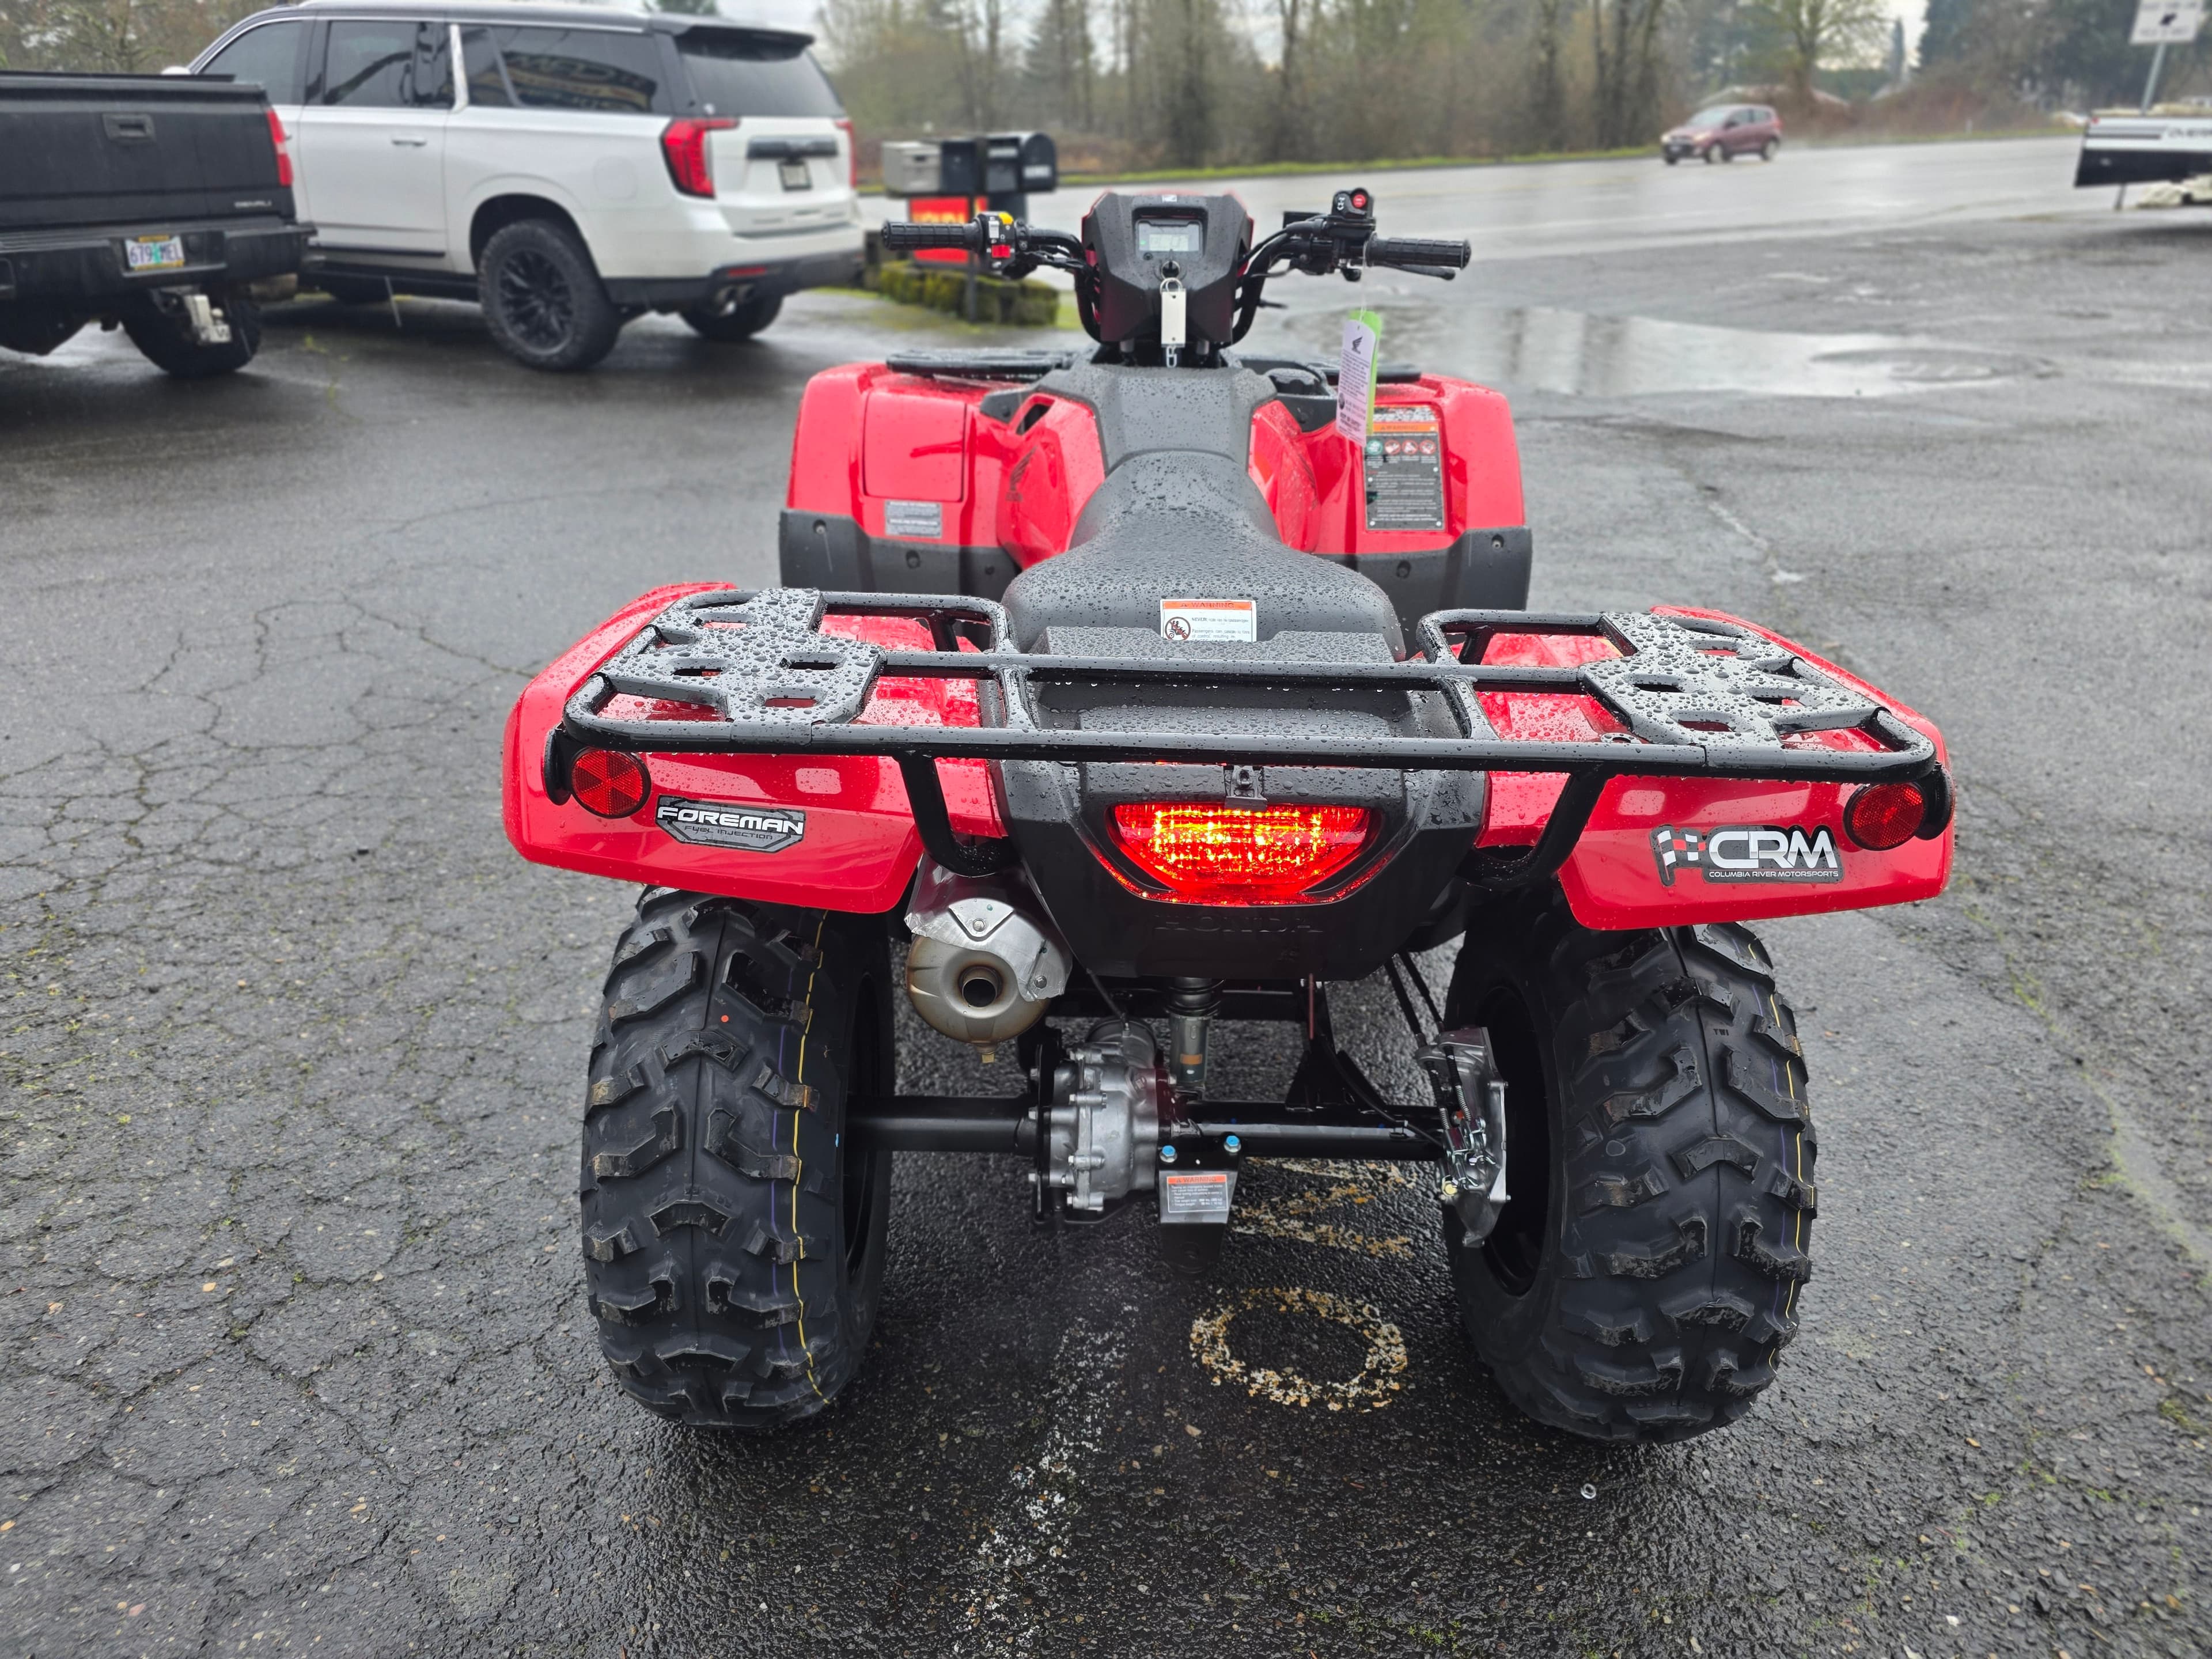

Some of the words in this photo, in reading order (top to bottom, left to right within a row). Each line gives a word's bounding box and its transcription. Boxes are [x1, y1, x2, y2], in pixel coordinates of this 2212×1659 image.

[657, 806, 804, 835] FOREMAN
[684, 825, 714, 835] FUEL
[717, 829, 773, 840] INJECTION
[1709, 830, 1838, 869] CRM
[1153, 914, 1324, 933] HONDA
